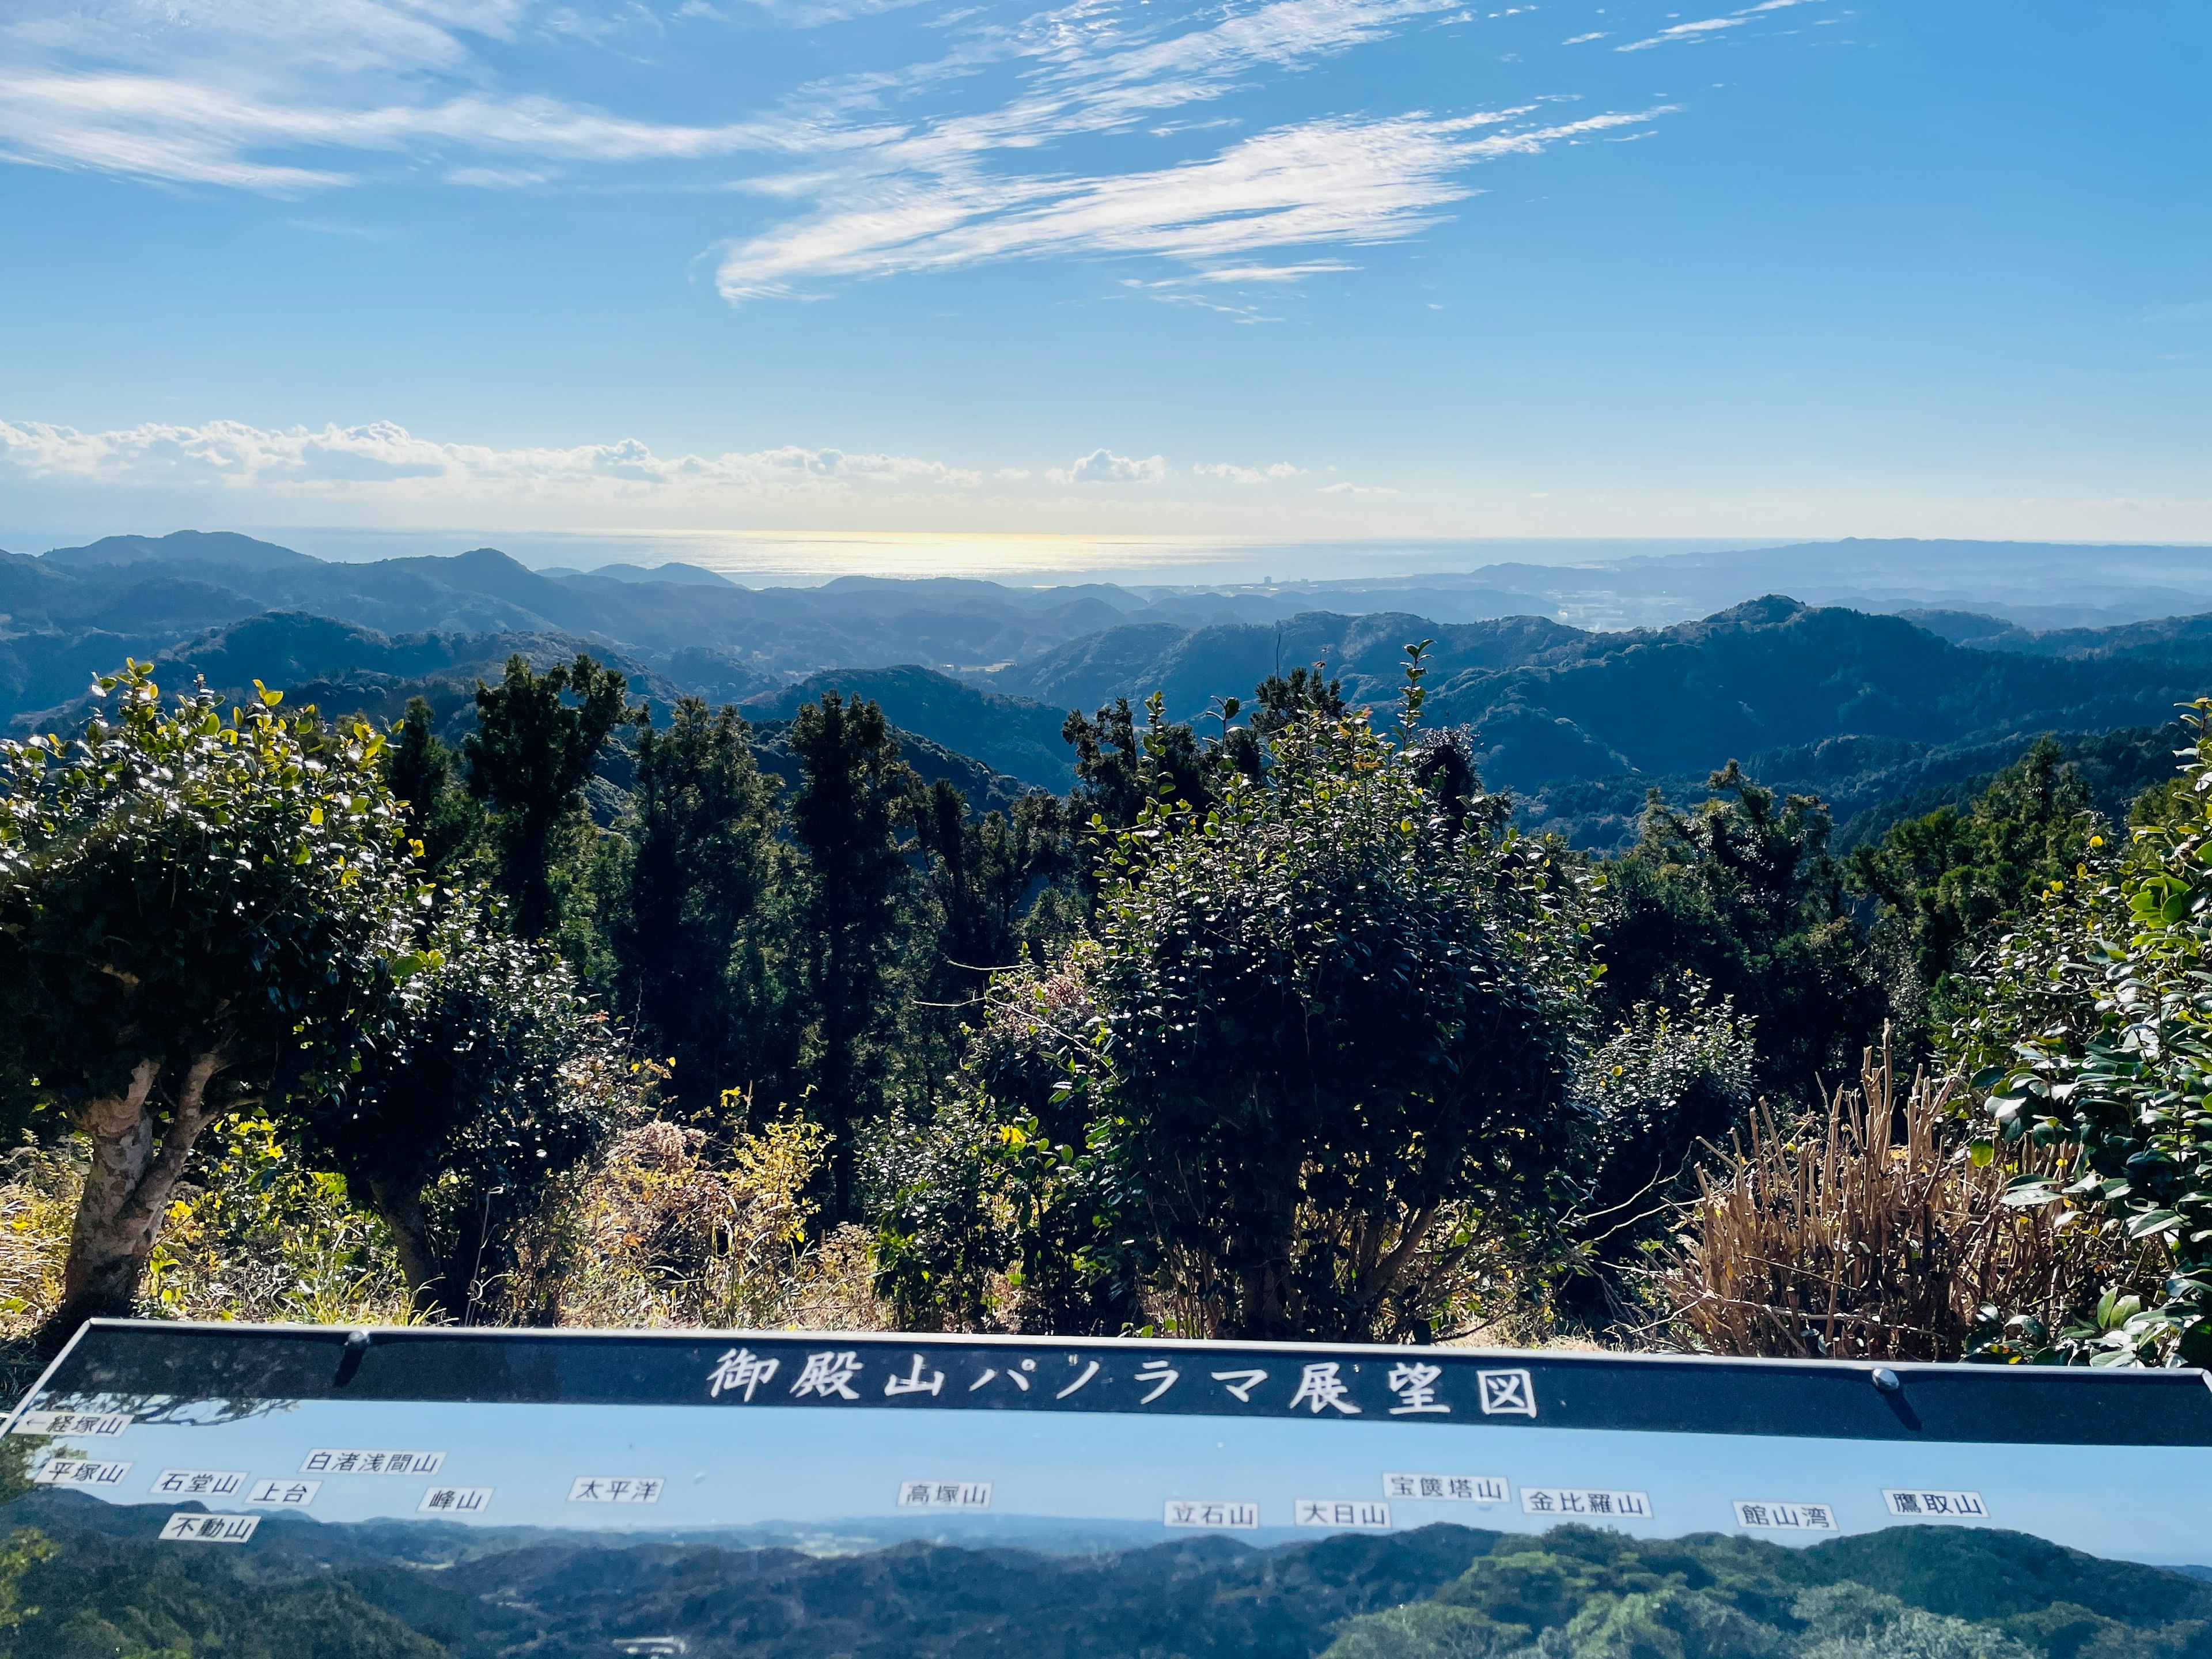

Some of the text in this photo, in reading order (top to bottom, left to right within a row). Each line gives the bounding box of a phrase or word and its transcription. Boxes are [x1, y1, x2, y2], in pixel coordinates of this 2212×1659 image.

[707, 1349, 1537, 1418] 御殿山パノラマ展望図
[46, 1415, 123, 1434] 経塚山
[48, 1462, 123, 1483] 平塚山
[306, 1452, 438, 1474] 白渚浅間山
[161, 1473, 239, 1494] 石堂山
[253, 1482, 308, 1502] 上台
[576, 1480, 658, 1500] 太平洋
[906, 1484, 986, 1504] 高塚山
[428, 1490, 483, 1510] 峰山
[1529, 1491, 1643, 1515] 金比羅山
[1893, 1493, 1982, 1515] 鷹取山
[1172, 1503, 1252, 1525] 立石山
[1303, 1503, 1385, 1525] 大日山
[1742, 1504, 1830, 1528] 館山湾
[171, 1517, 252, 1539] 不動山
